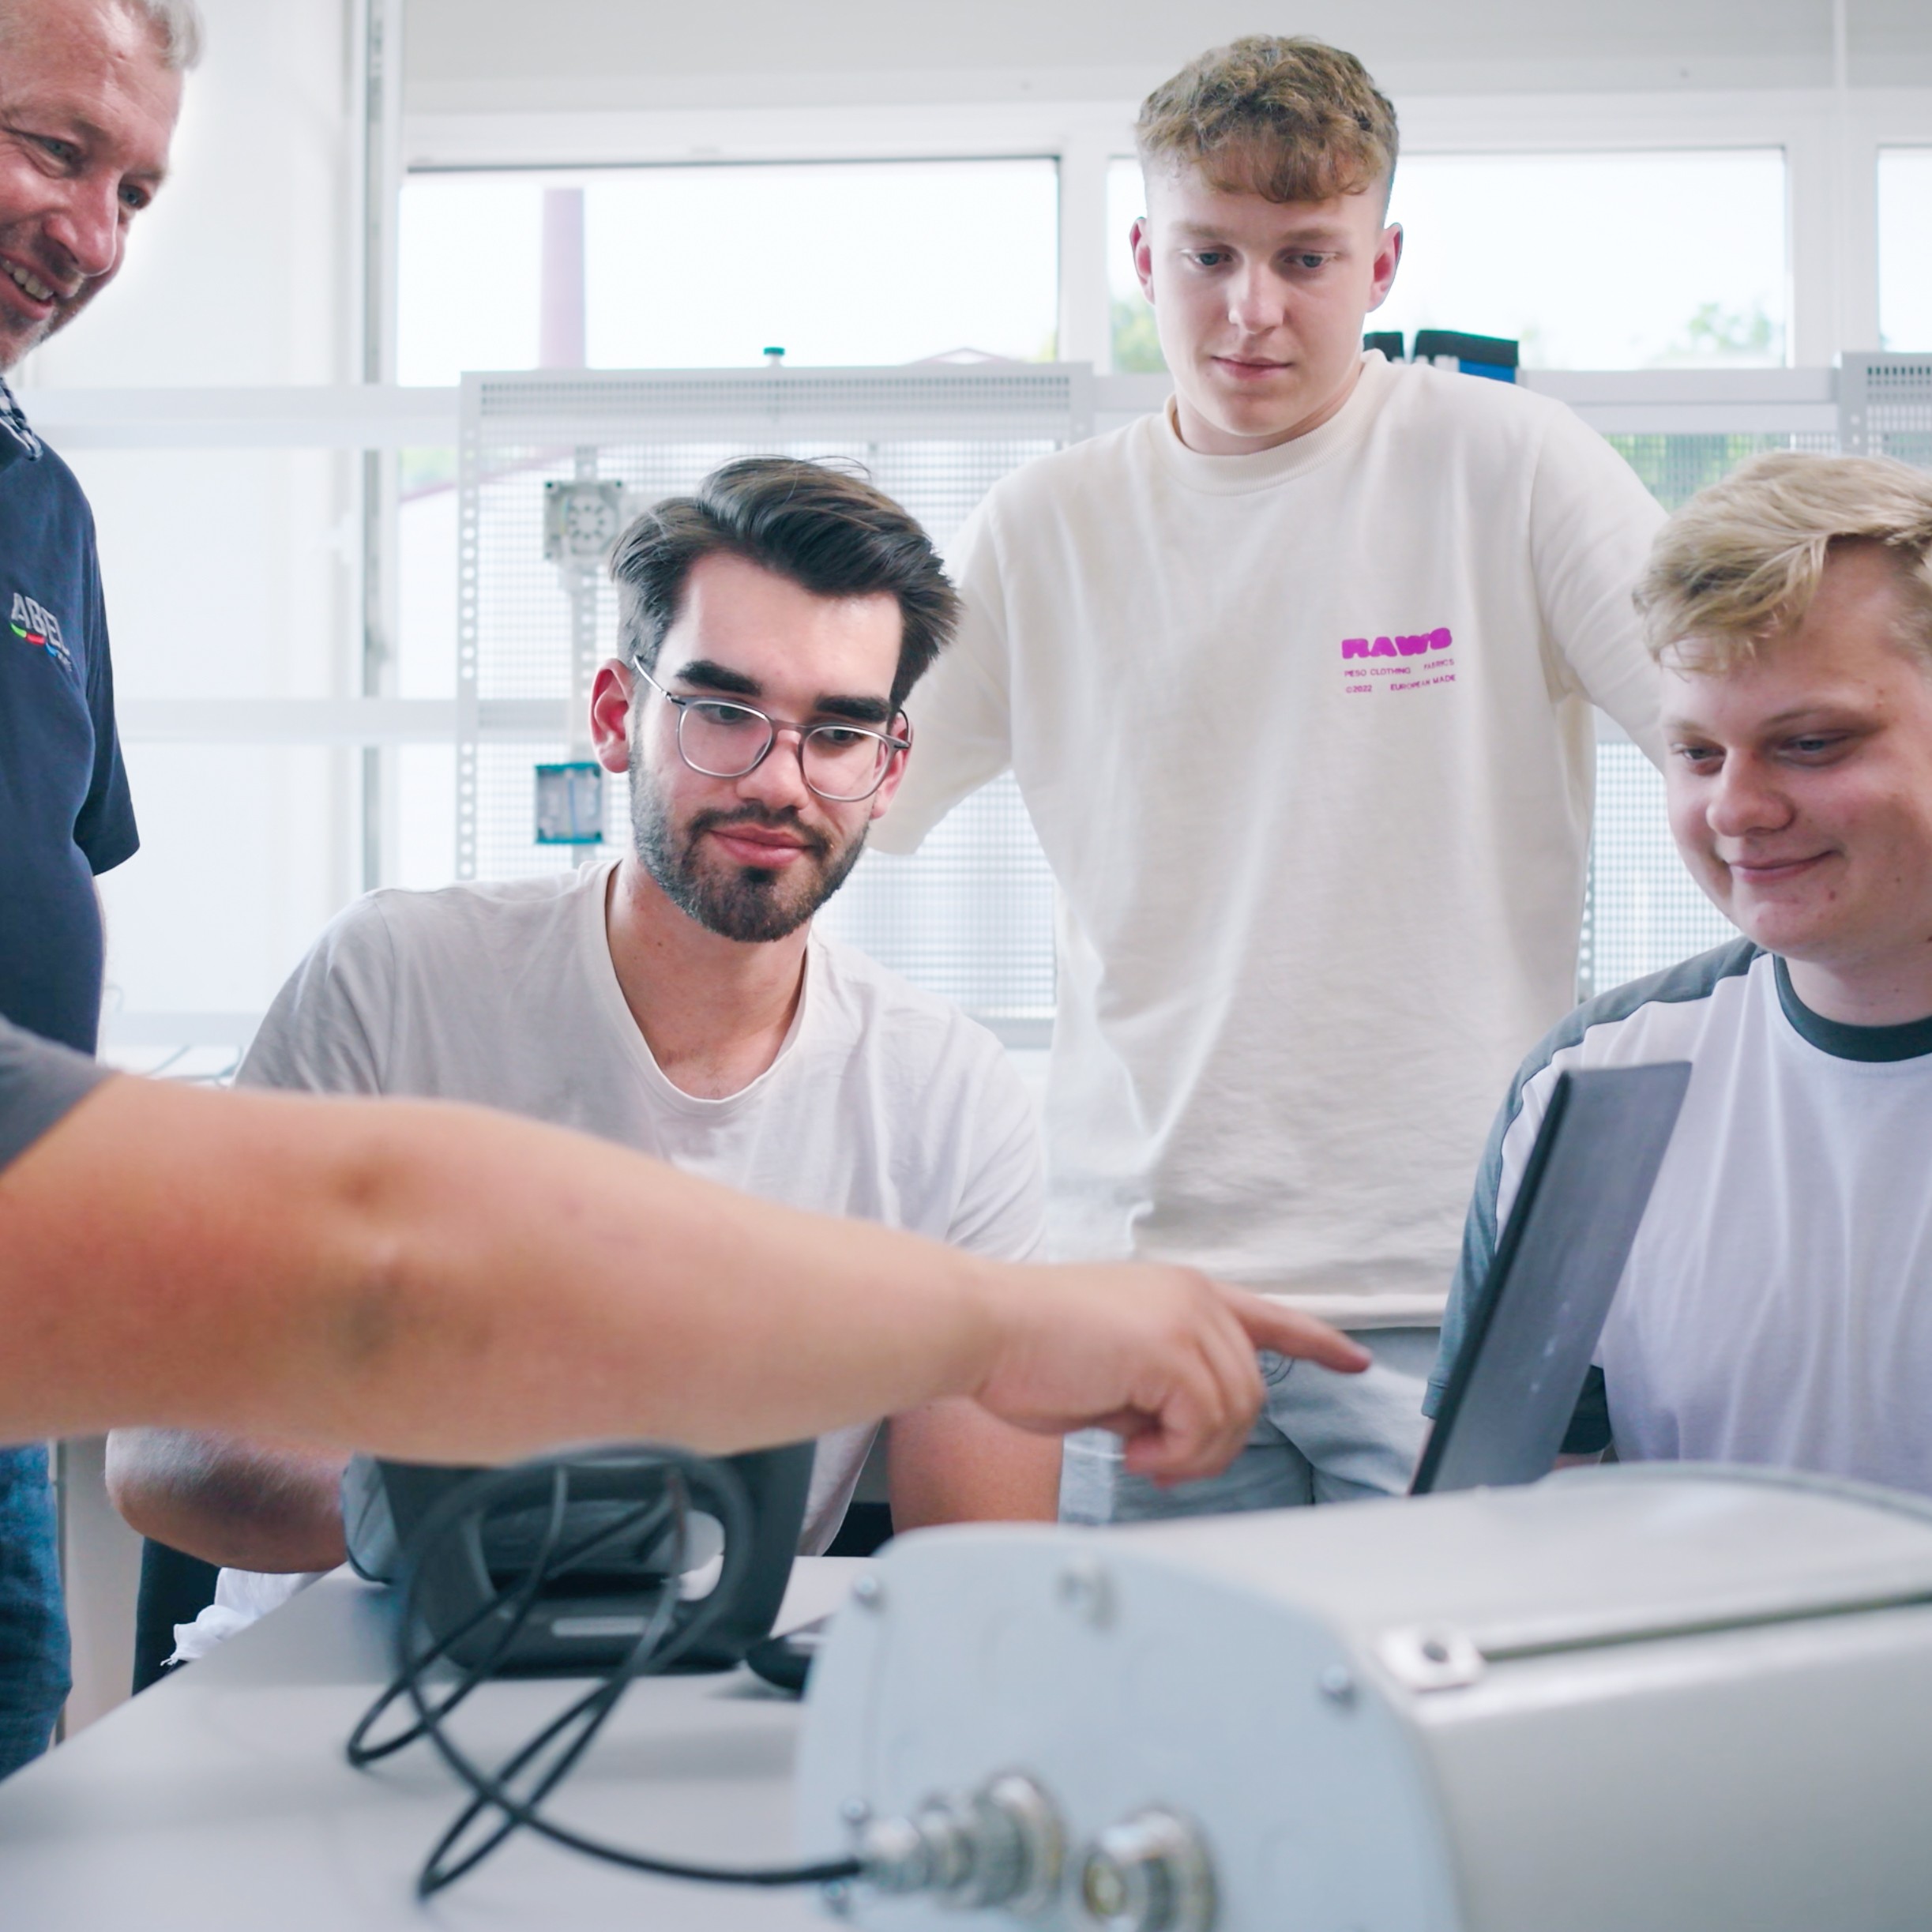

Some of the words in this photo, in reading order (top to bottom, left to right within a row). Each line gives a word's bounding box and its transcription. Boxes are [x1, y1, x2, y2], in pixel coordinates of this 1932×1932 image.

[1370, 667, 1411, 676] CLOTHING
[1390, 679, 1430, 691] EUROPEAN
[1432, 674, 1457, 684] MADE
